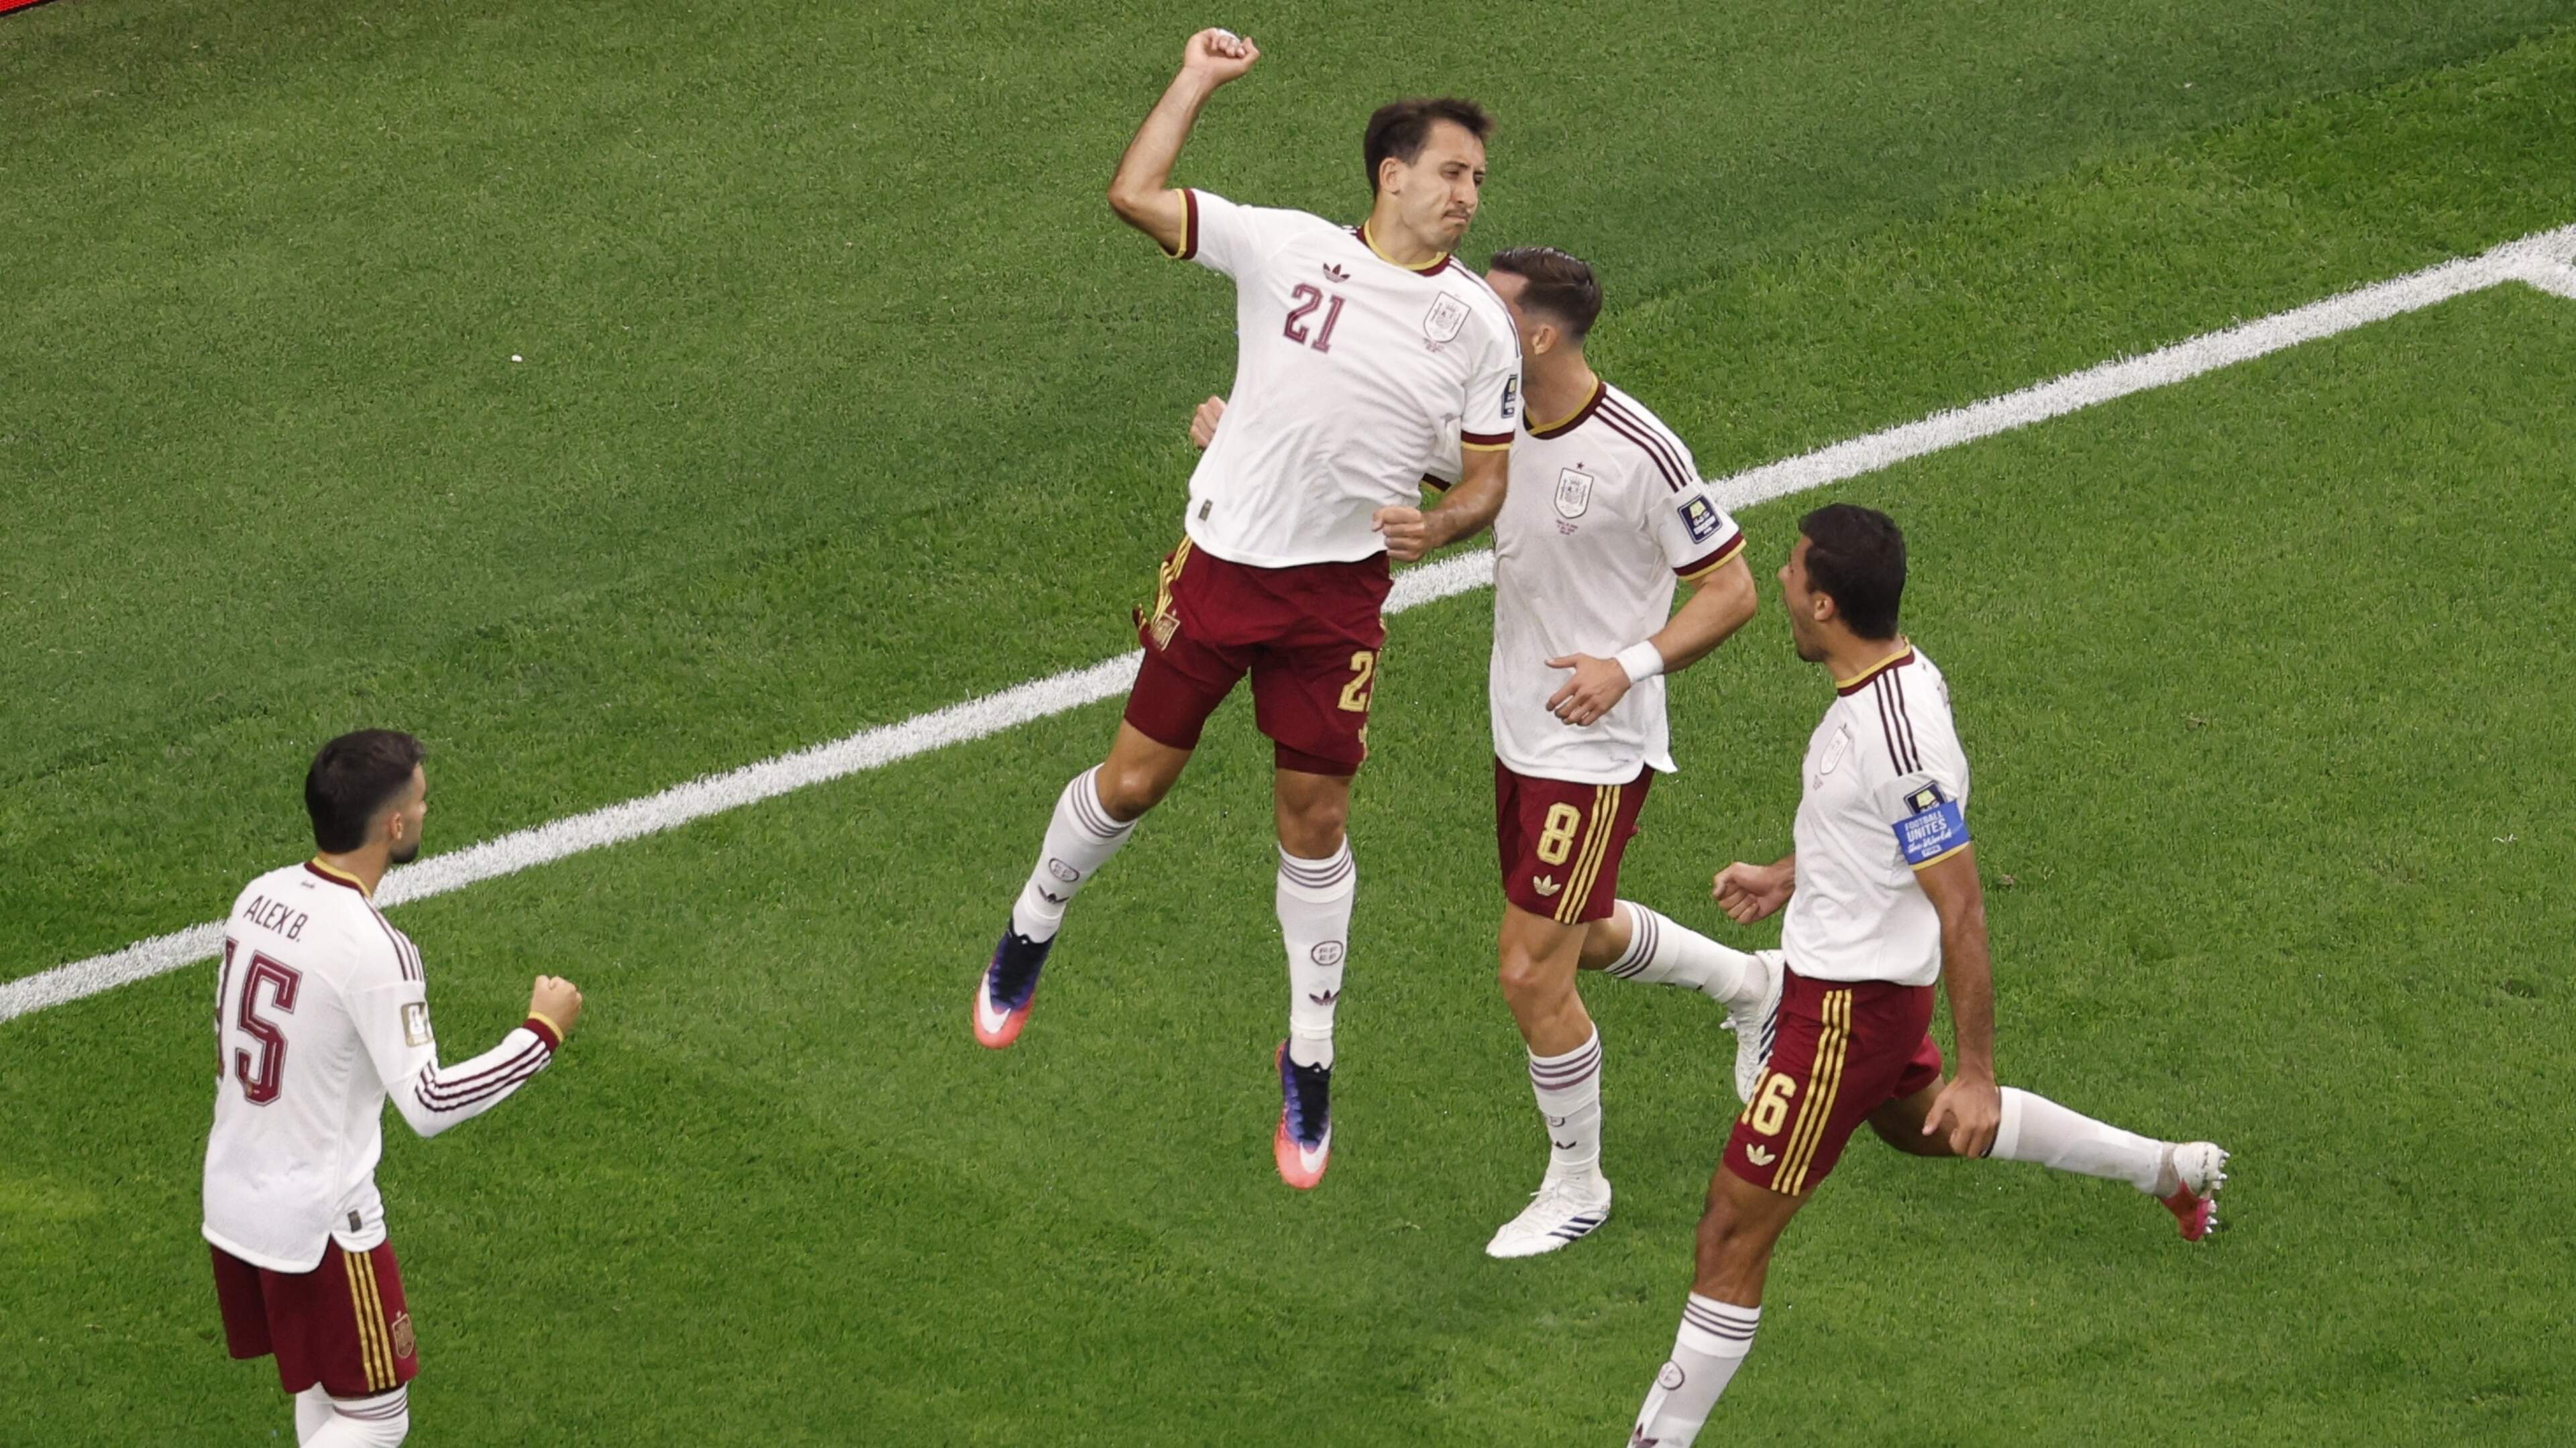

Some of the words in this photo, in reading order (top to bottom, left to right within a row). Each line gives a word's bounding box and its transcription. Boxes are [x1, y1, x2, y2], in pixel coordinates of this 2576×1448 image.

[1283, 282, 1346, 354] 21
[1337, 651, 1381, 712] 2
[1536, 801, 1582, 867] 8
[1904, 810, 1943, 832] FOOTBALL
[1907, 818, 1947, 842] UNITES
[243, 895, 296, 934] ALEX
[286, 912, 309, 943] B.
